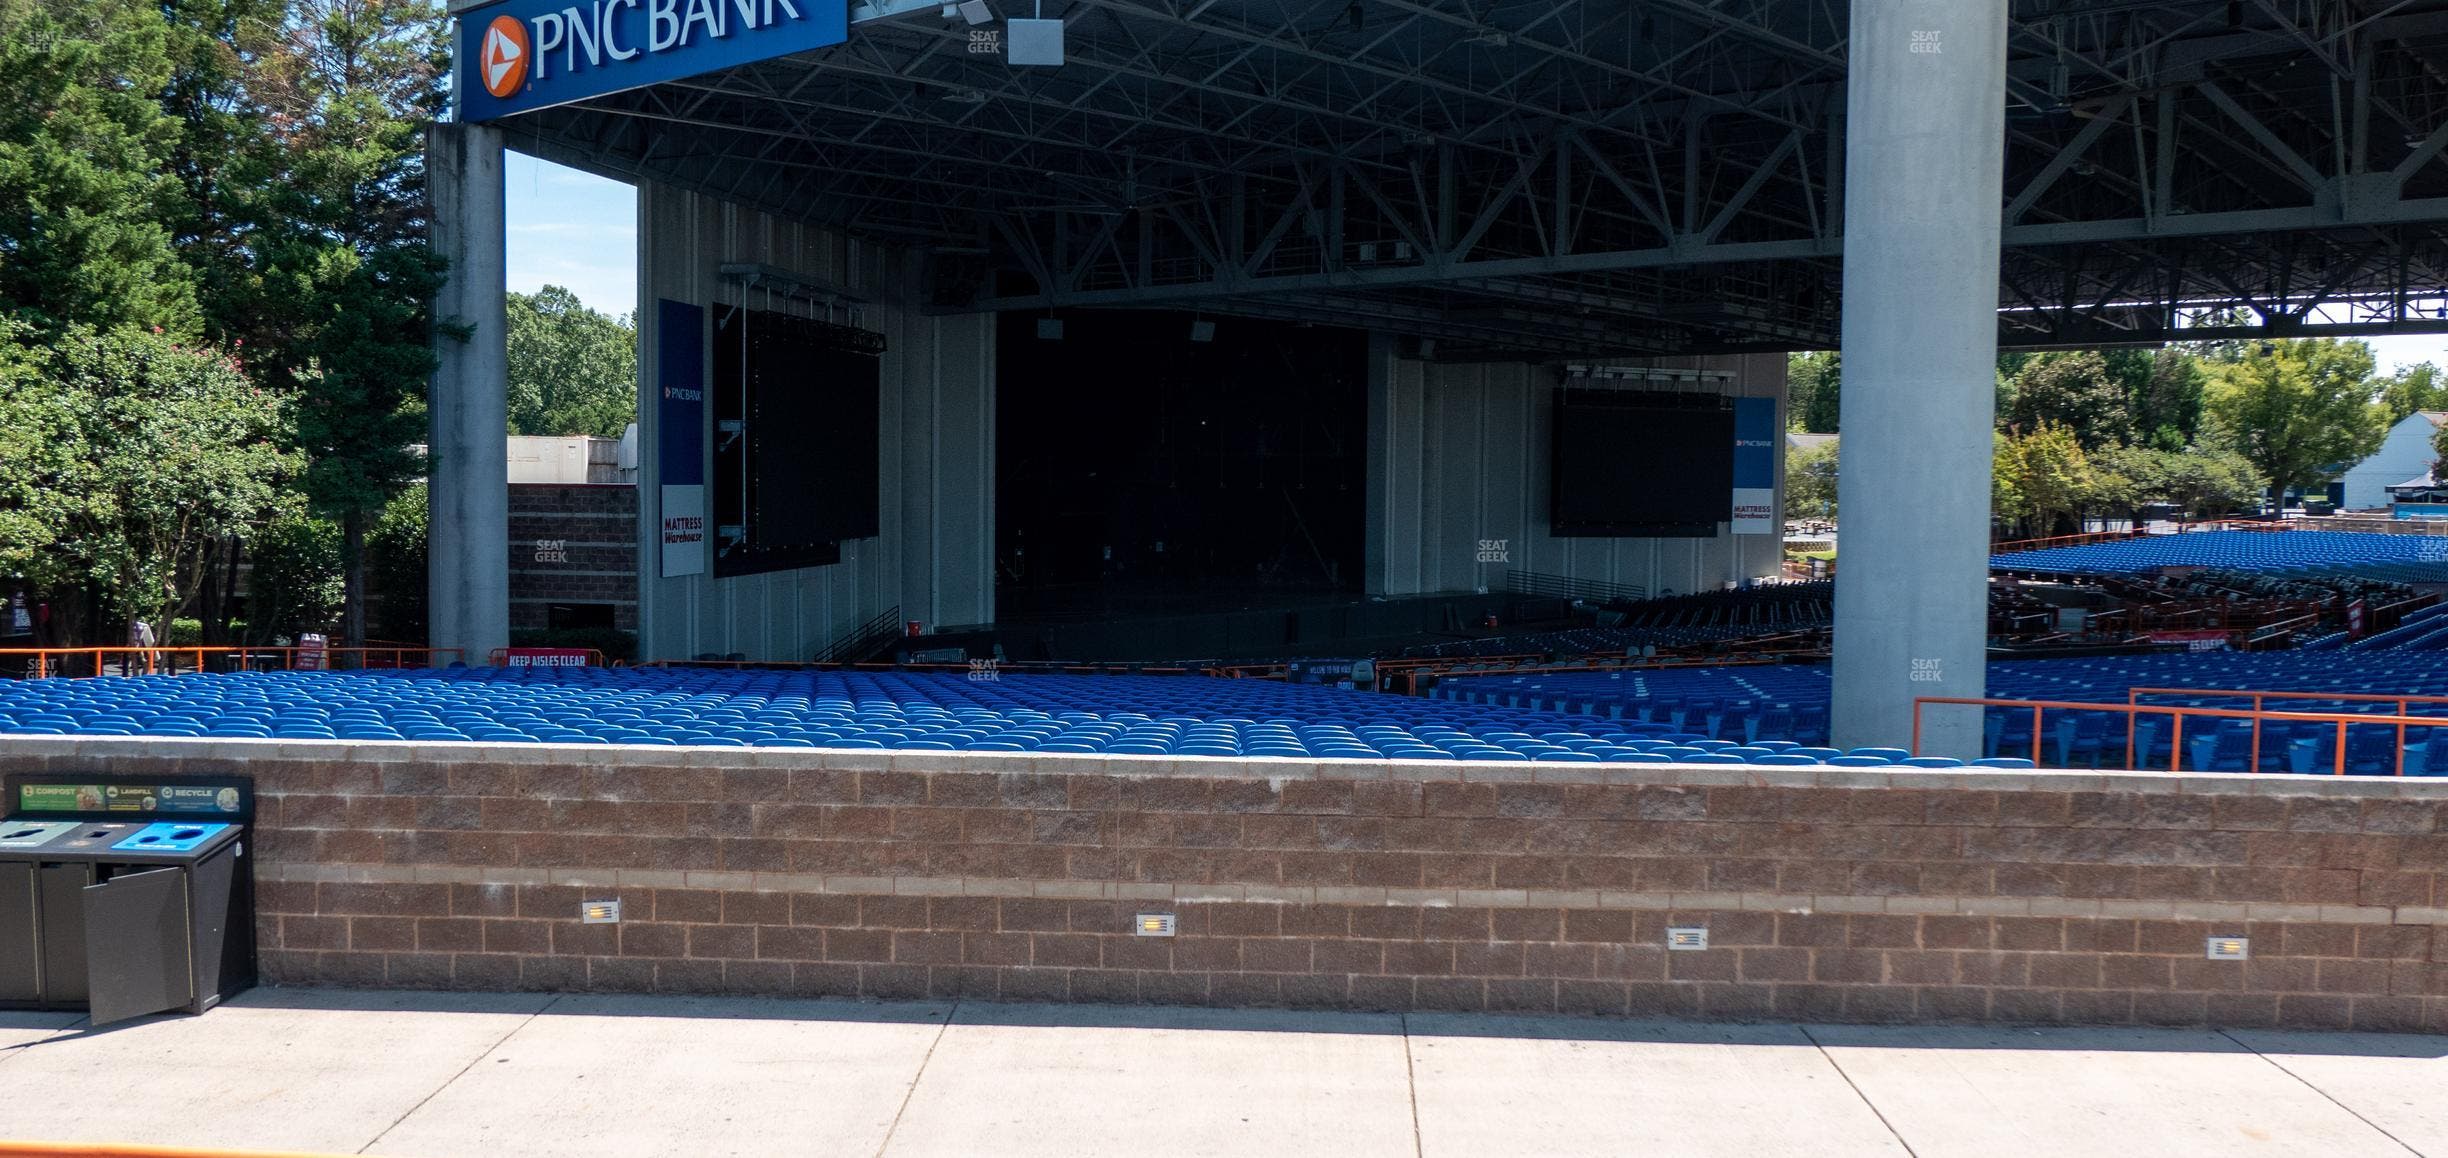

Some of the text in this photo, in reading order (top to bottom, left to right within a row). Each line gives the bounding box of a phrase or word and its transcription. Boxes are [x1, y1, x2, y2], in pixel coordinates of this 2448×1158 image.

[664, 516, 703, 531] MATTRESS
[509, 655, 586, 667] KEEP AISLES CLEAR
[35, 787, 76, 796] COMPOST
[120, 788, 152, 796] LANDFILL
[175, 788, 213, 797] RECYCLE
